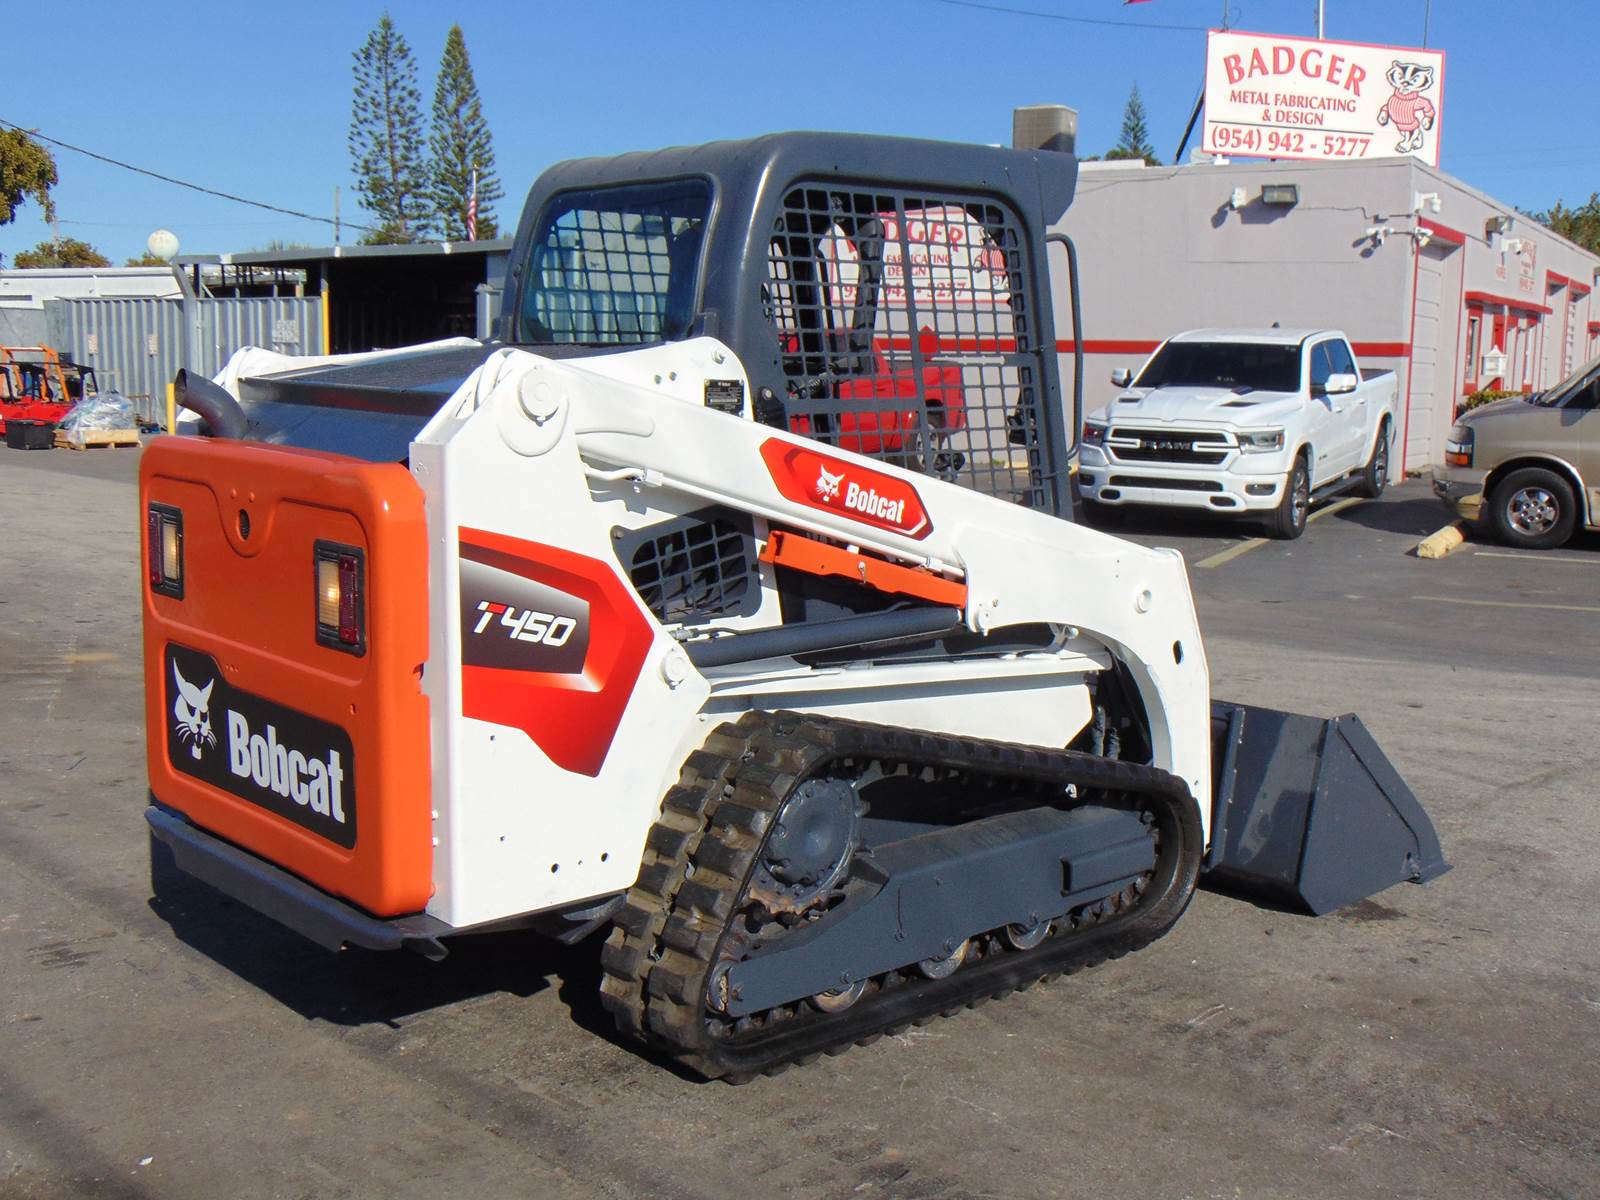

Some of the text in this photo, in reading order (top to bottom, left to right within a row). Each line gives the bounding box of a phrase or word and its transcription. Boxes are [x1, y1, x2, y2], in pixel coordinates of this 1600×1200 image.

[1223, 46, 1366, 97] BADGER
[1230, 90, 1357, 113] METAL FABRICATING
[1262, 108, 1324, 126] & DESIGN
[1212, 126, 1262, 151] (954)
[1268, 131, 1304, 153] 942
[1323, 135, 1371, 157] 5277
[845, 482, 905, 523] Bobcat
[473, 601, 577, 647] T450
[227, 709, 345, 824] Bobcat
